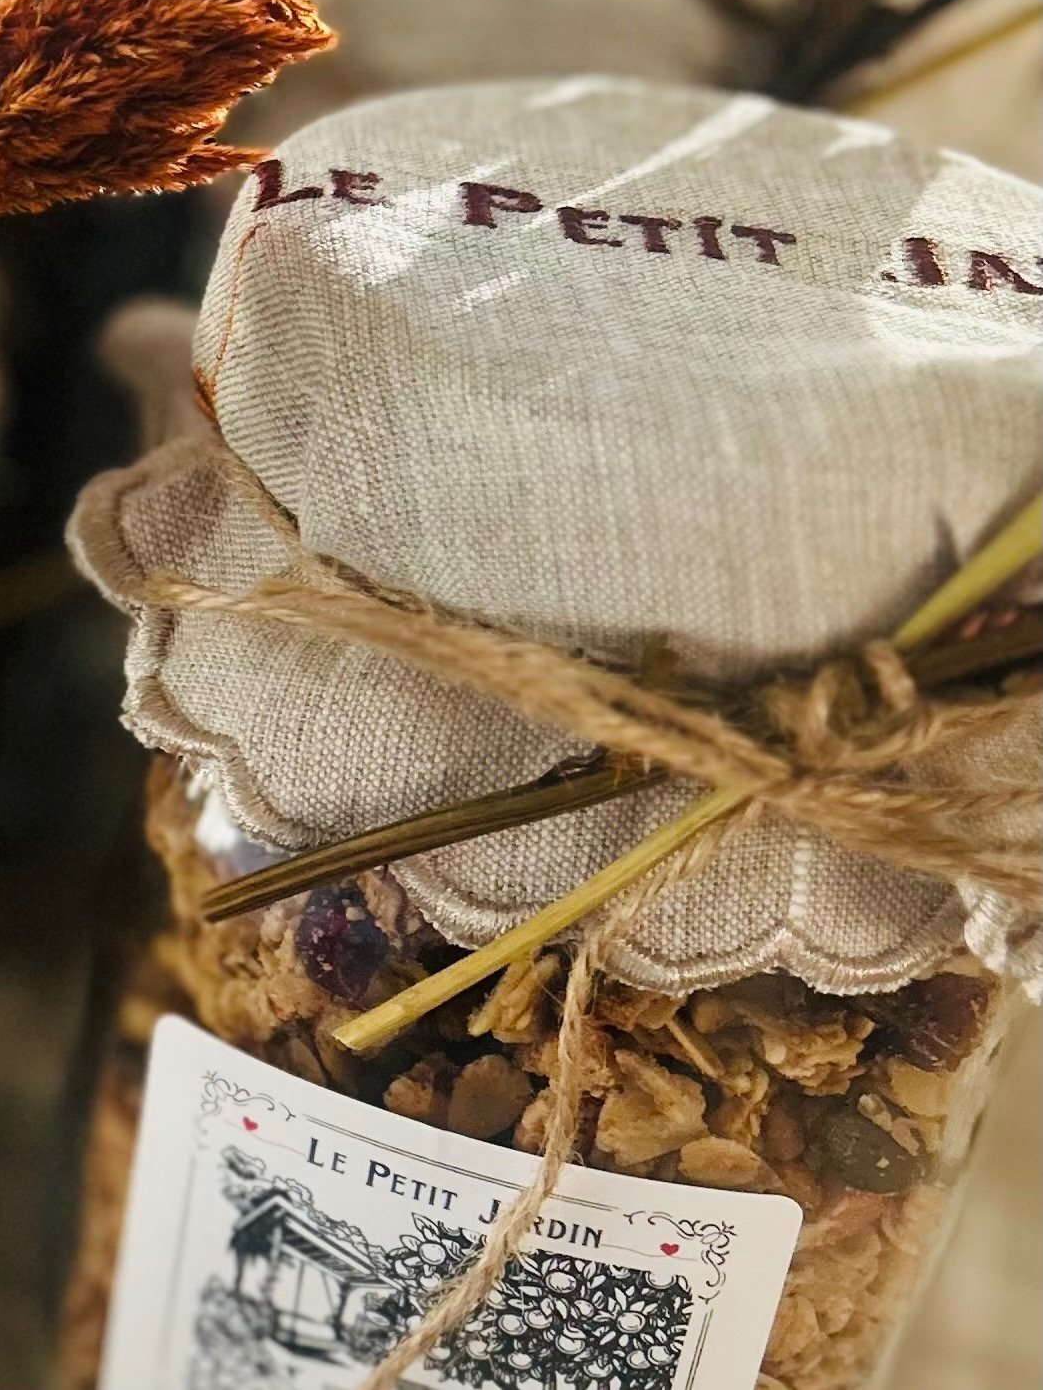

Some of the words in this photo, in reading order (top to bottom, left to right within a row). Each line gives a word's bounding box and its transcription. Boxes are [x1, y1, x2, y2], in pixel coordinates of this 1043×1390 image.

[252, 159, 384, 212] LE
[459, 181, 796, 266] PETIT
[307, 1137, 347, 1175] LE
[365, 1159, 458, 1211] PETIT
[478, 1198, 604, 1249] JRDIN
